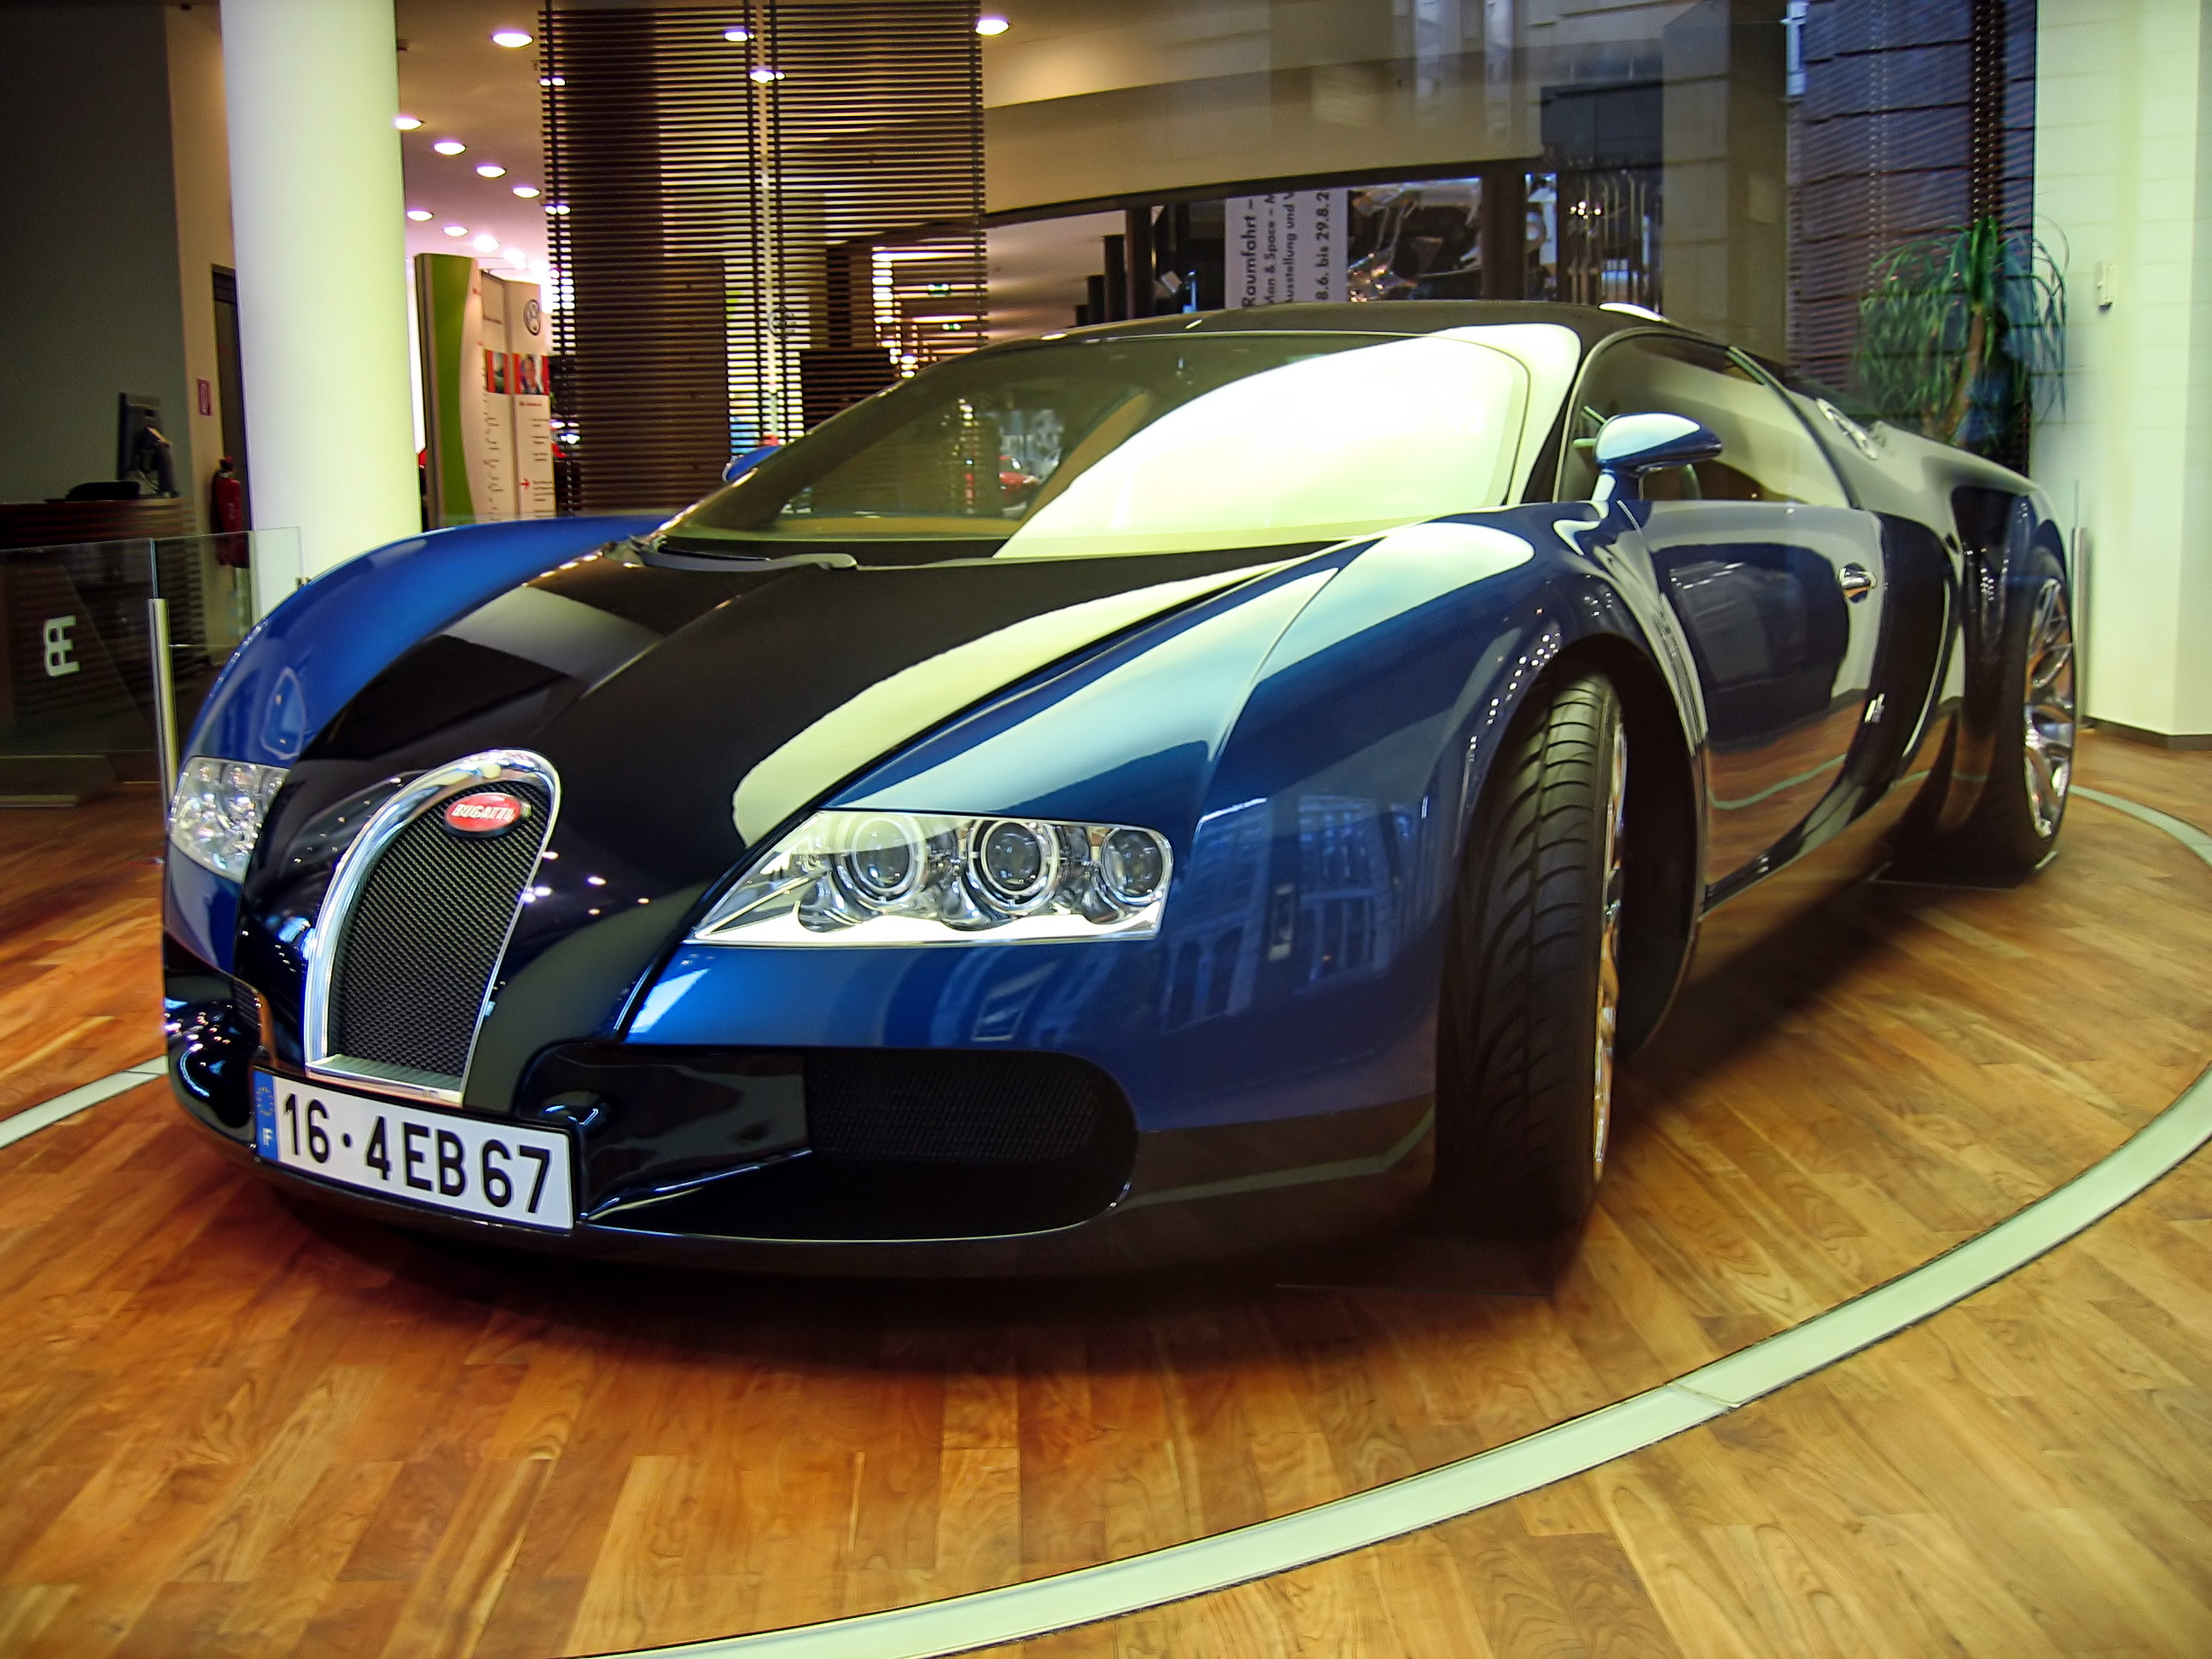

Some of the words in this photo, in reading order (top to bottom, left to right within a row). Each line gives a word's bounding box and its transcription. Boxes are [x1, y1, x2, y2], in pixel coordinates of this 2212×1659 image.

[1283, 204, 1295, 228] und
[1264, 221, 1278, 259] Space
[1241, 215, 1257, 307] Raumfahrt
[1315, 247, 1329, 267] bis
[1264, 265, 1276, 273] &
[451, 803, 515, 822] BUGATTI
[261, 1127, 274, 1147] F
